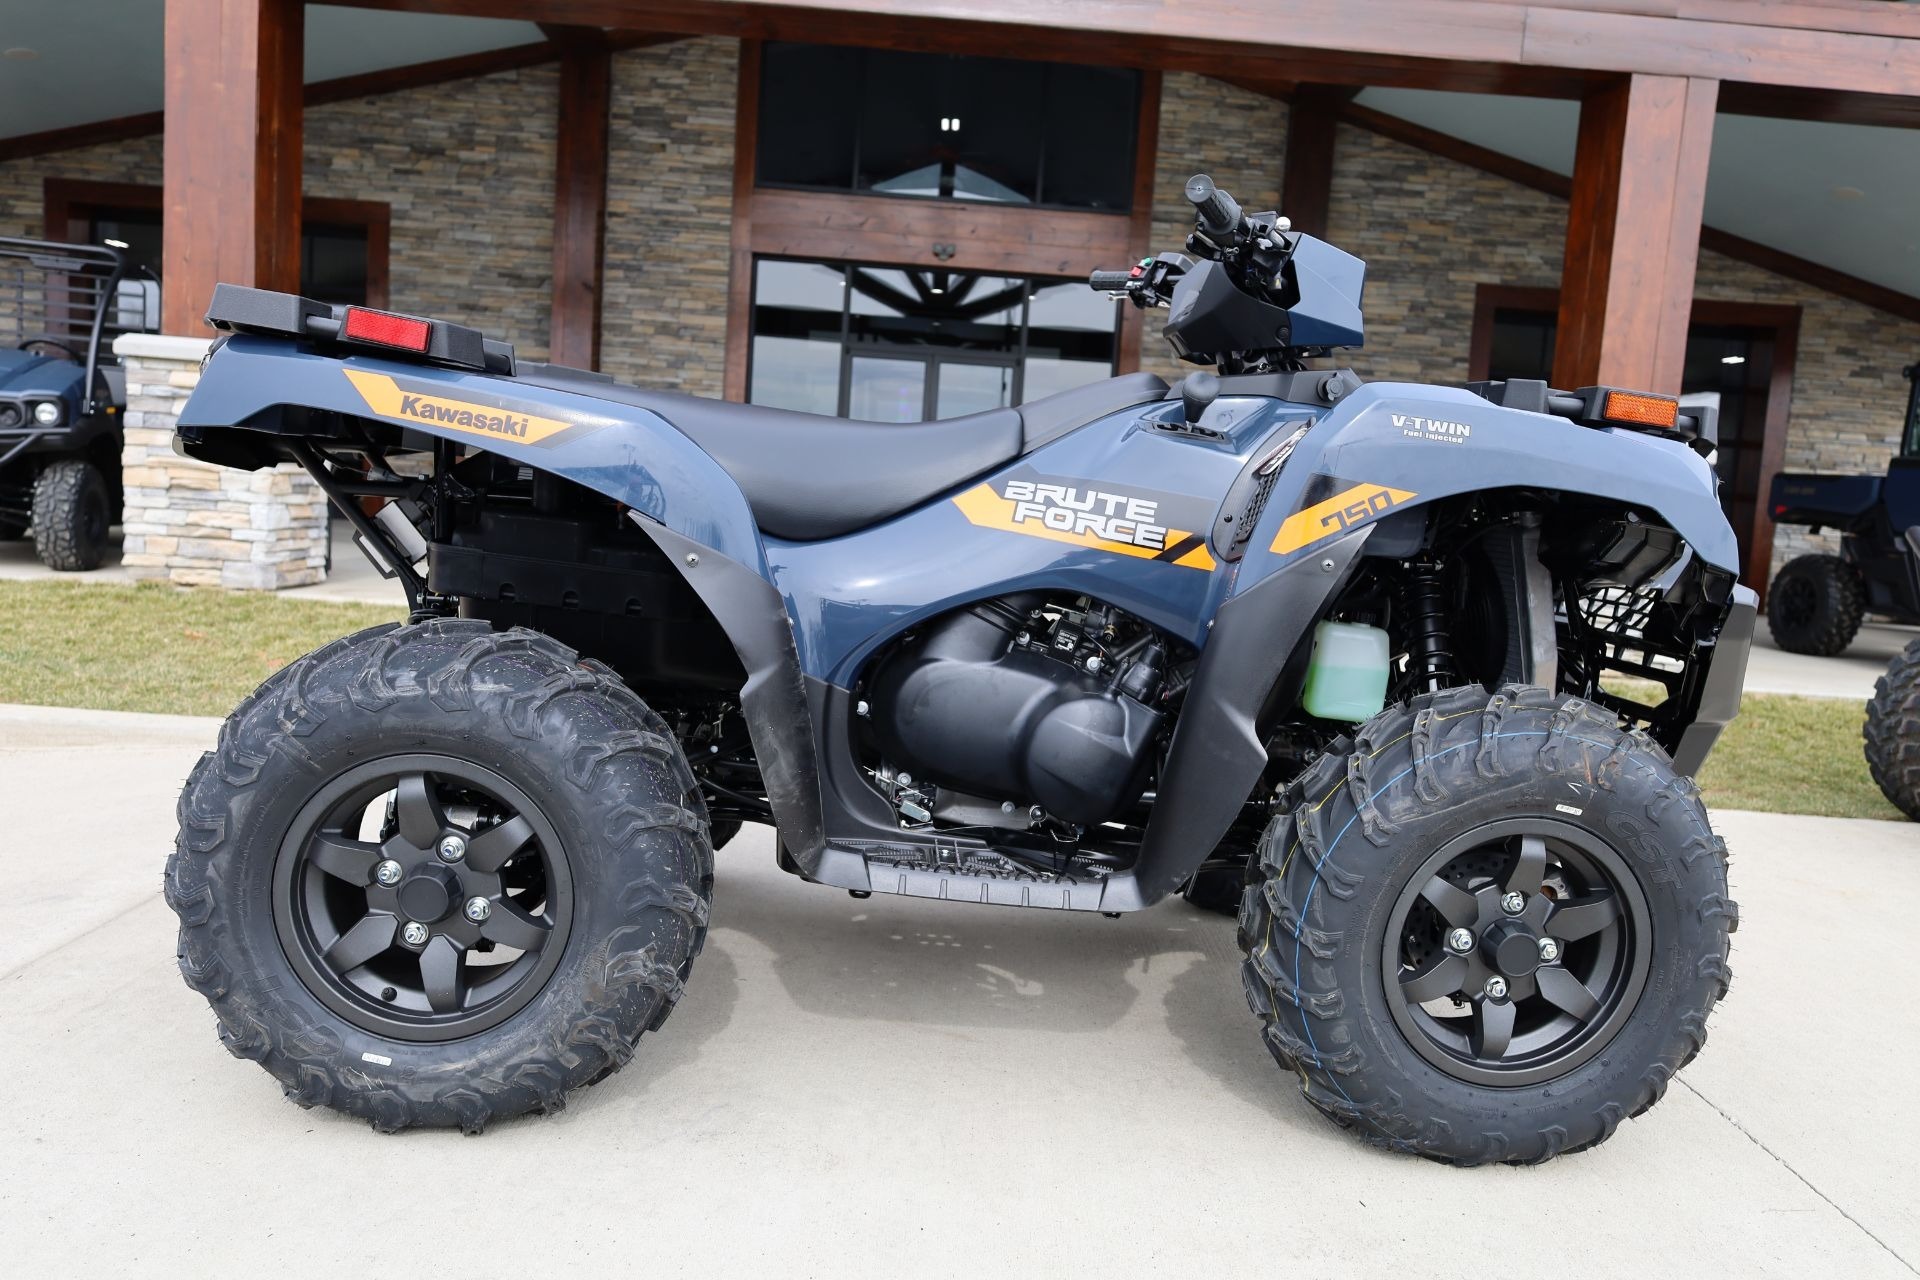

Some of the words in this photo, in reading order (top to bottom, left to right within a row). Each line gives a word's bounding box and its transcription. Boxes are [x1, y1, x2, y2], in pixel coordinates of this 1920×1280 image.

[400, 395, 528, 437] Kawasaki
[1391, 414, 1471, 437] V-TWIN
[1403, 429, 1422, 438] Fuel
[1425, 432, 1463, 444] Injected
[1004, 480, 1159, 524] BRUTE
[1320, 490, 1394, 531] 750
[1014, 502, 1167, 550] FORCE
[1605, 811, 1684, 890] CST
